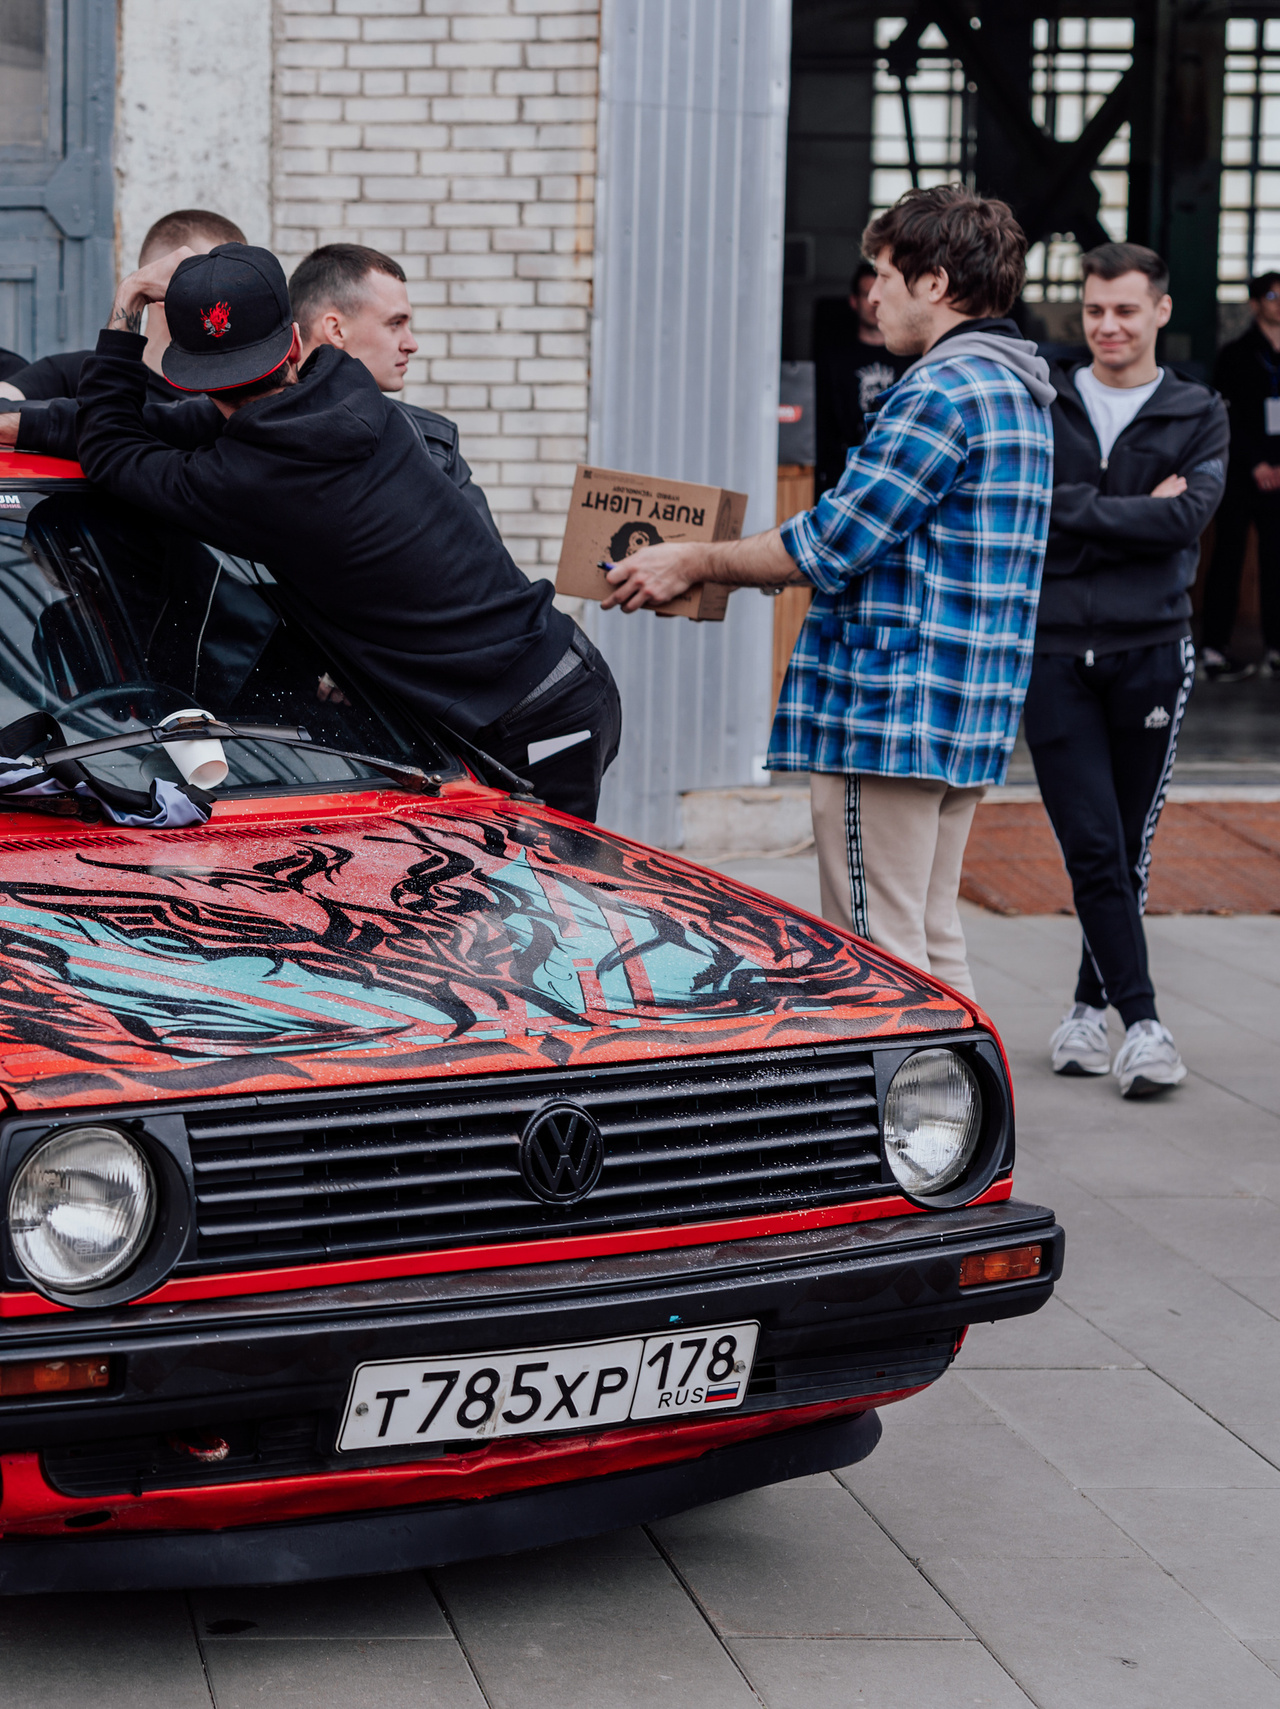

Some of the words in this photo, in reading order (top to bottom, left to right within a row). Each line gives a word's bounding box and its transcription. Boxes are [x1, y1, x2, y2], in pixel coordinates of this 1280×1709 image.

[581, 491, 642, 516] LIGHT
[649, 502, 705, 526] RUBY
[647, 1335, 738, 1391] 178
[657, 1386, 705, 1409] RUS
